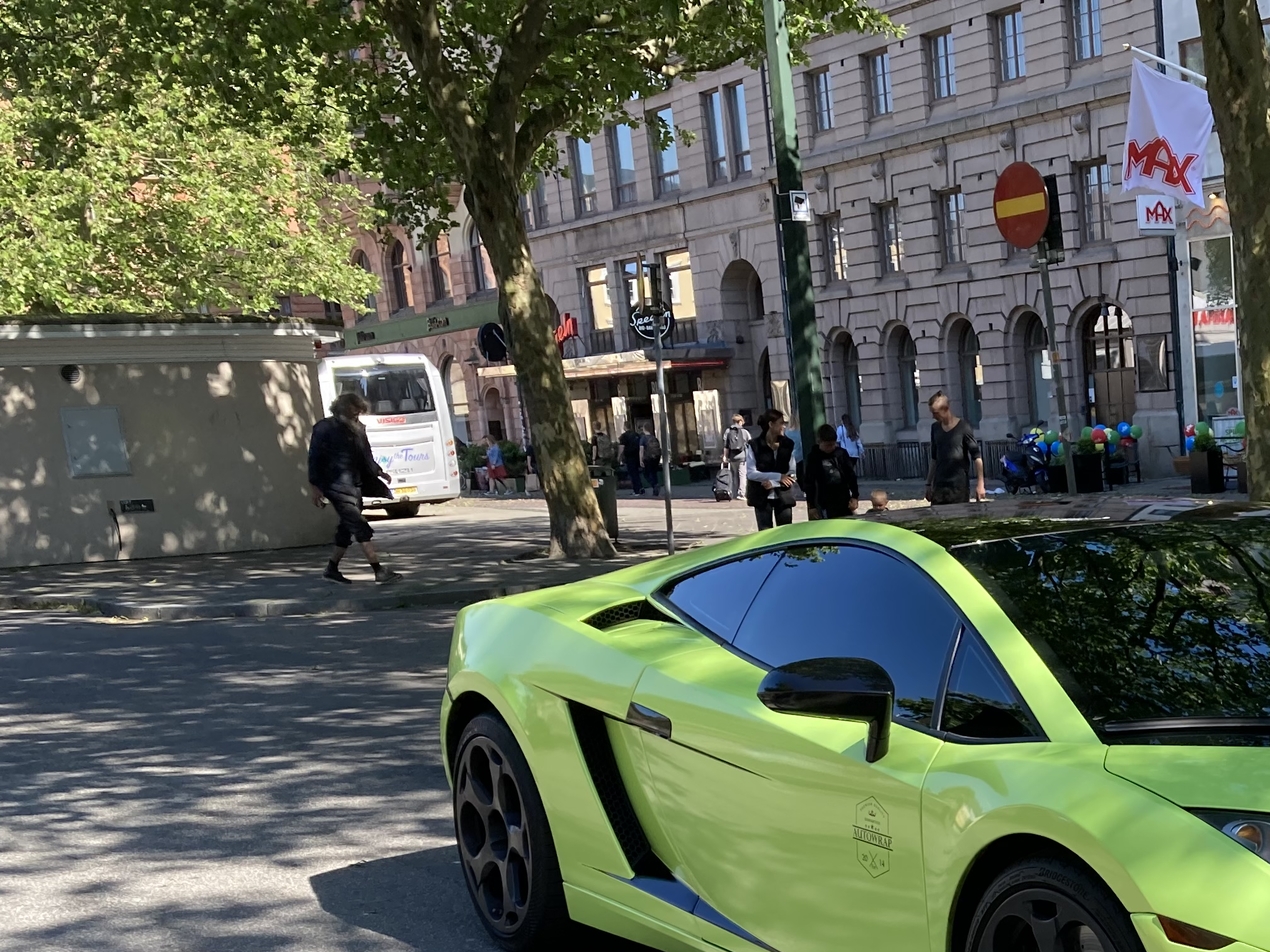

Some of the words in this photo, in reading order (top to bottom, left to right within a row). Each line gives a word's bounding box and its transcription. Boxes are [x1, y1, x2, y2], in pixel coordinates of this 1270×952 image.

[1124, 135, 1199, 195] MAX
[1145, 200, 1173, 224] MAX
[401, 447, 430, 462] Tours
[853, 828, 892, 848] AUTOWRAP
[1038, 867, 1090, 901] BRIDGESTONE
